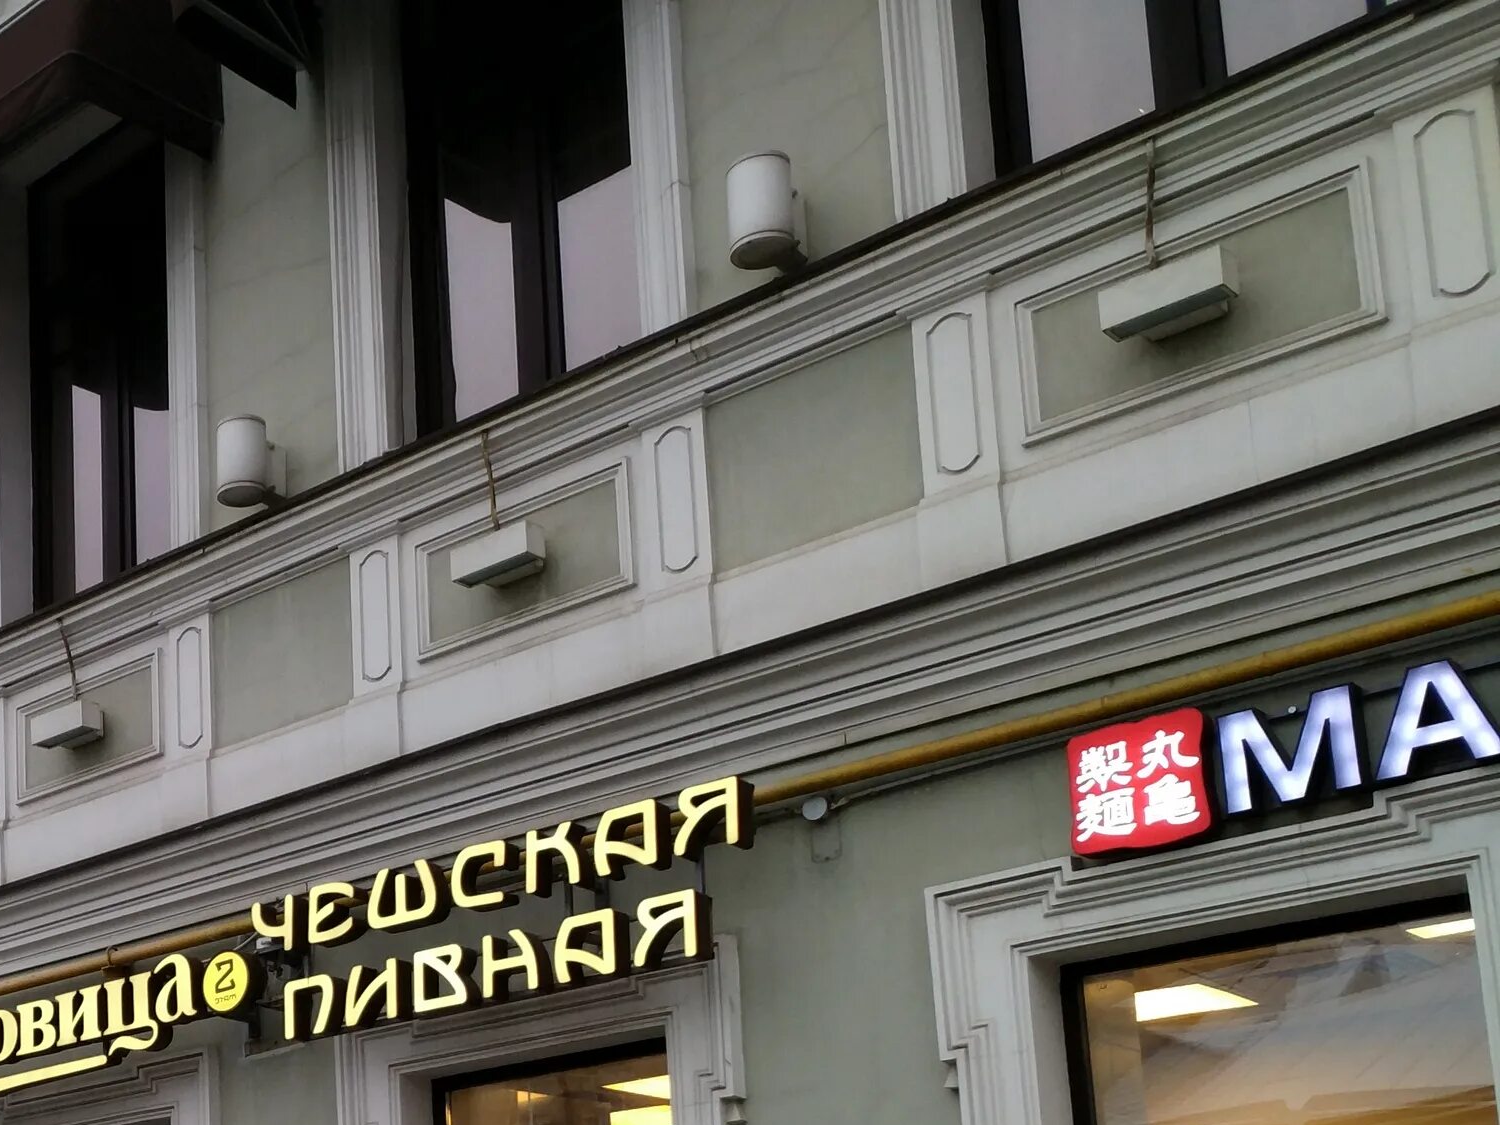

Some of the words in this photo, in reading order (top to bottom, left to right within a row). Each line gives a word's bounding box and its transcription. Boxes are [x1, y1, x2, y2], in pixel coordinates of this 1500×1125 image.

[250, 776, 739, 951] ЧЕШСКАЯ
[214, 958, 237, 994] 2
[283, 889, 699, 1041] ПИВНАЯ
